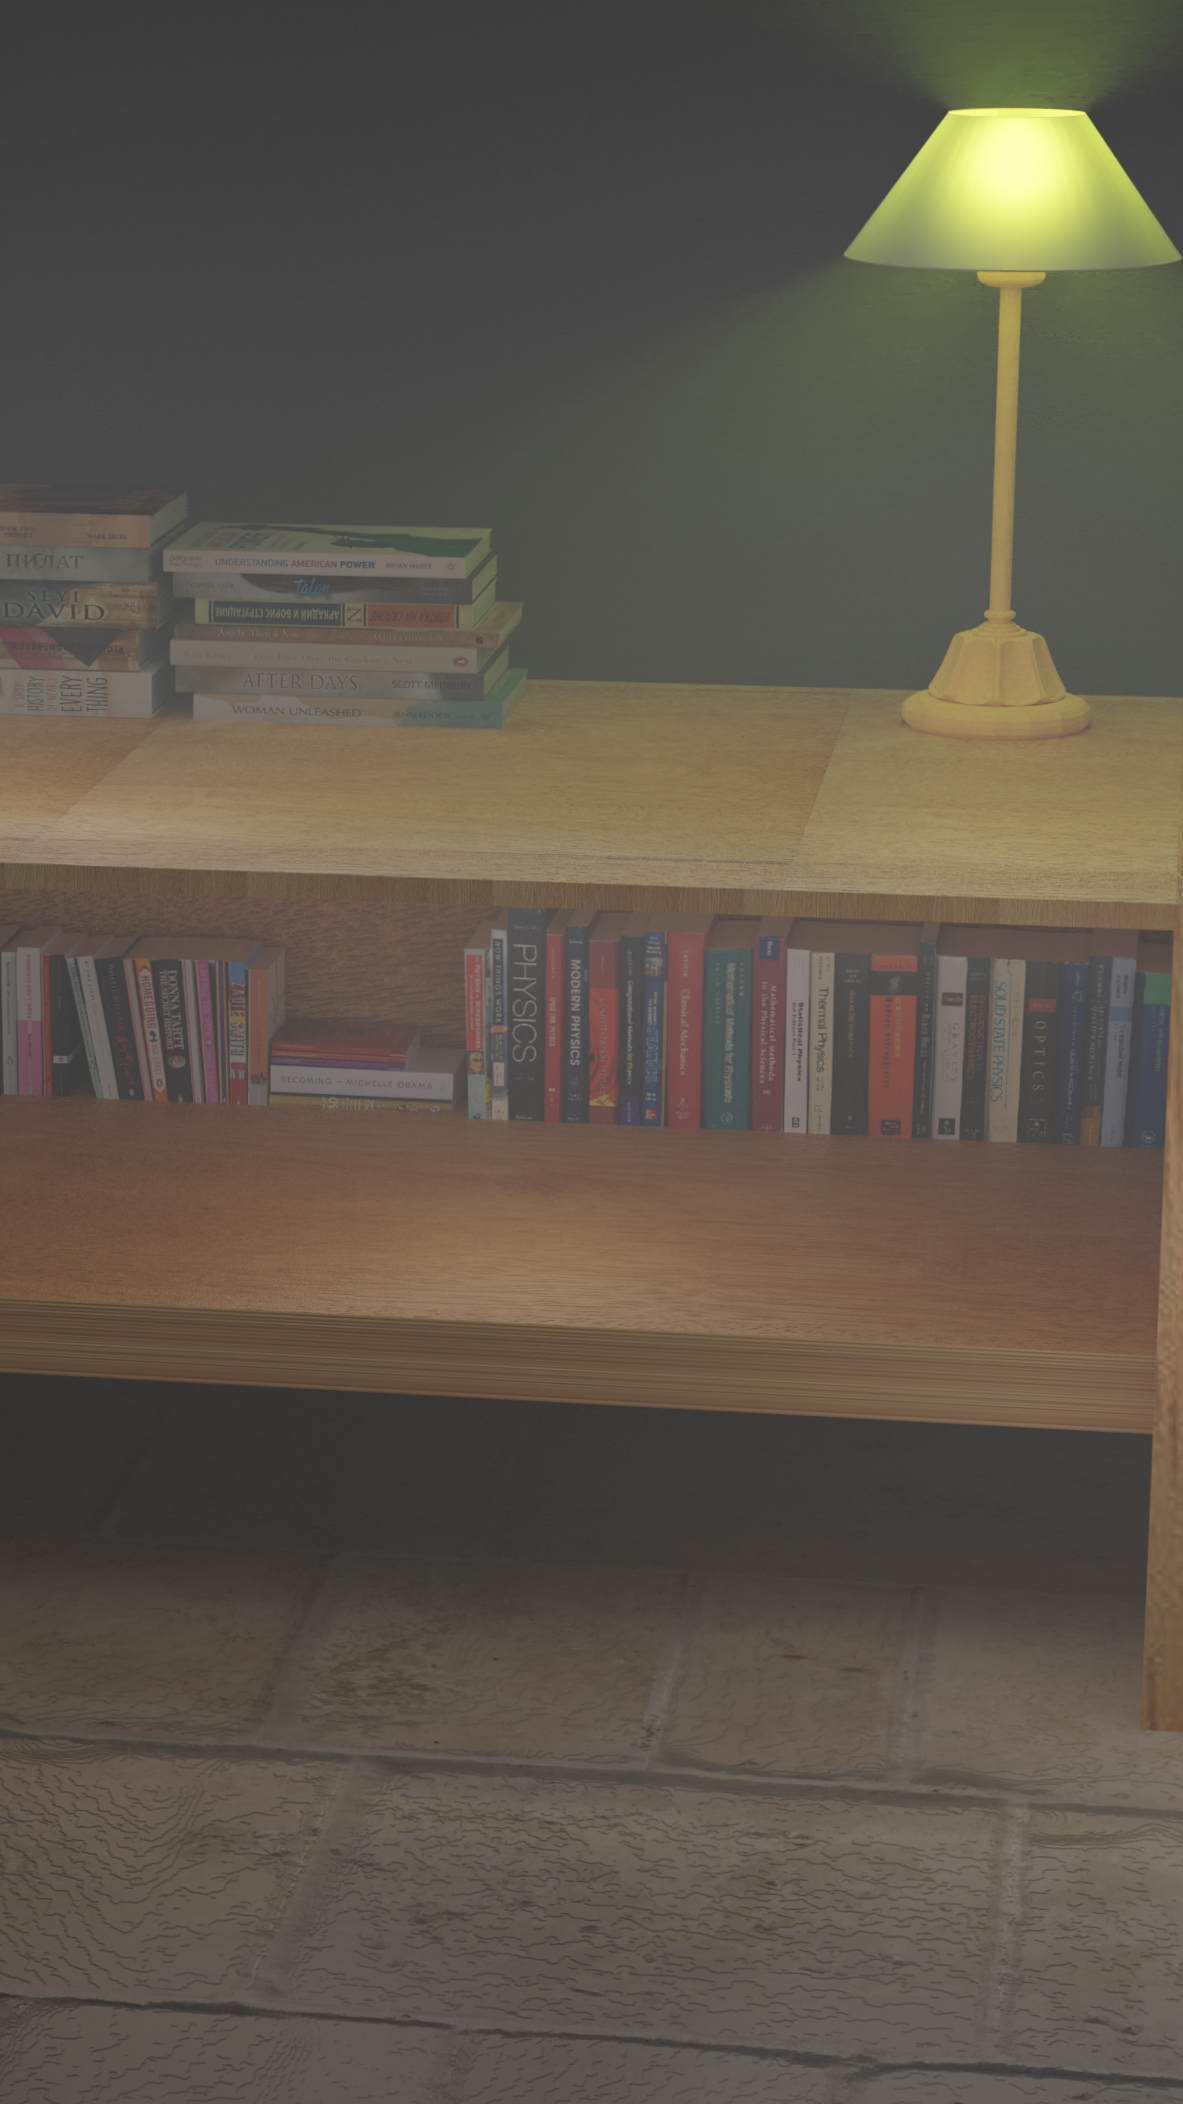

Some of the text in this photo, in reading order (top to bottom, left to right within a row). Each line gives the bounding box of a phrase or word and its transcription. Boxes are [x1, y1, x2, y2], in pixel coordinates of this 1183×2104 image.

[169, 555, 202, 563] palgrave
[214, 558, 375, 569] UNDERSTANDING AMERICAN POWER
[294, 577, 331, 600] talon
[2, 602, 105, 620] DAVID
[214, 606, 340, 620] АРКАДИЙ И БОРИС СТРУГАЦКИЕ
[370, 610, 452, 623] УЛИТКА НА СКЛОНЕ
[218, 628, 301, 638] Angela, Then & Now
[184, 650, 232, 660] Ken Kesey
[278, 653, 297, 661] Flew
[302, 654, 324, 662] Over
[346, 655, 388, 663] Cuckoo's
[14, 681, 25, 700] SHORT
[27, 676, 44, 711] HISTORY
[47, 677, 58, 712] OF NEARLY
[60, 675, 82, 712] EVERY
[86, 677, 108, 712] THING
[242, 672, 357, 691] AFTER DAYS
[392, 680, 472, 690] SCOTT MEDBURY
[232, 705, 362, 717] WOMAN UNLEASHED
[394, 711, 416, 719] JENN
[198, 964, 209, 998] LIFTING
[762, 981, 768, 990] in
[140, 976, 157, 1029] HOMEGOING
[159, 970, 174, 1050] THE SECRET HISTORY
[167, 970, 184, 1050] DONNA TARTT
[230, 982, 246, 1056] ZADIE SMITH
[512, 944, 537, 1062] PHYSICS
[570, 959, 581, 1066] MODERN PHYSICS
[626, 980, 634, 1024] Computational
[817, 987, 829, 1030] Thermal
[679, 989, 690, 1076] Classical Mechanics
[723, 963, 736, 1103] Mathematical Methods for Physicists
[759, 1010, 768, 1045] Physical
[768, 985, 777, 1081] Mathematical Methods
[921, 1014, 930, 1034] BLACK
[967, 995, 977, 1080] ELECTRODYNAMICS
[977, 995, 985, 1061] INTRODUCTION
[991, 980, 1007, 1102] SOLID STATE PHYSICS
[151, 1043, 162, 1075] YAA GYASI
[645, 1026, 658, 1083] STATICS
[816, 1033, 827, 1073] Physics
[882, 997, 893, 1089] Modern Astrophysics
[921, 1037, 930, 1058] HOLES
[951, 1023, 960, 1082] GRAVITY
[1033, 1020, 1047, 1091] OPTICS
[1117, 1034, 1125, 1060] Standard
[281, 1075, 433, 1090] BECOMING MICHELLE OBAMA
[759, 1048, 767, 1084] Sciences
